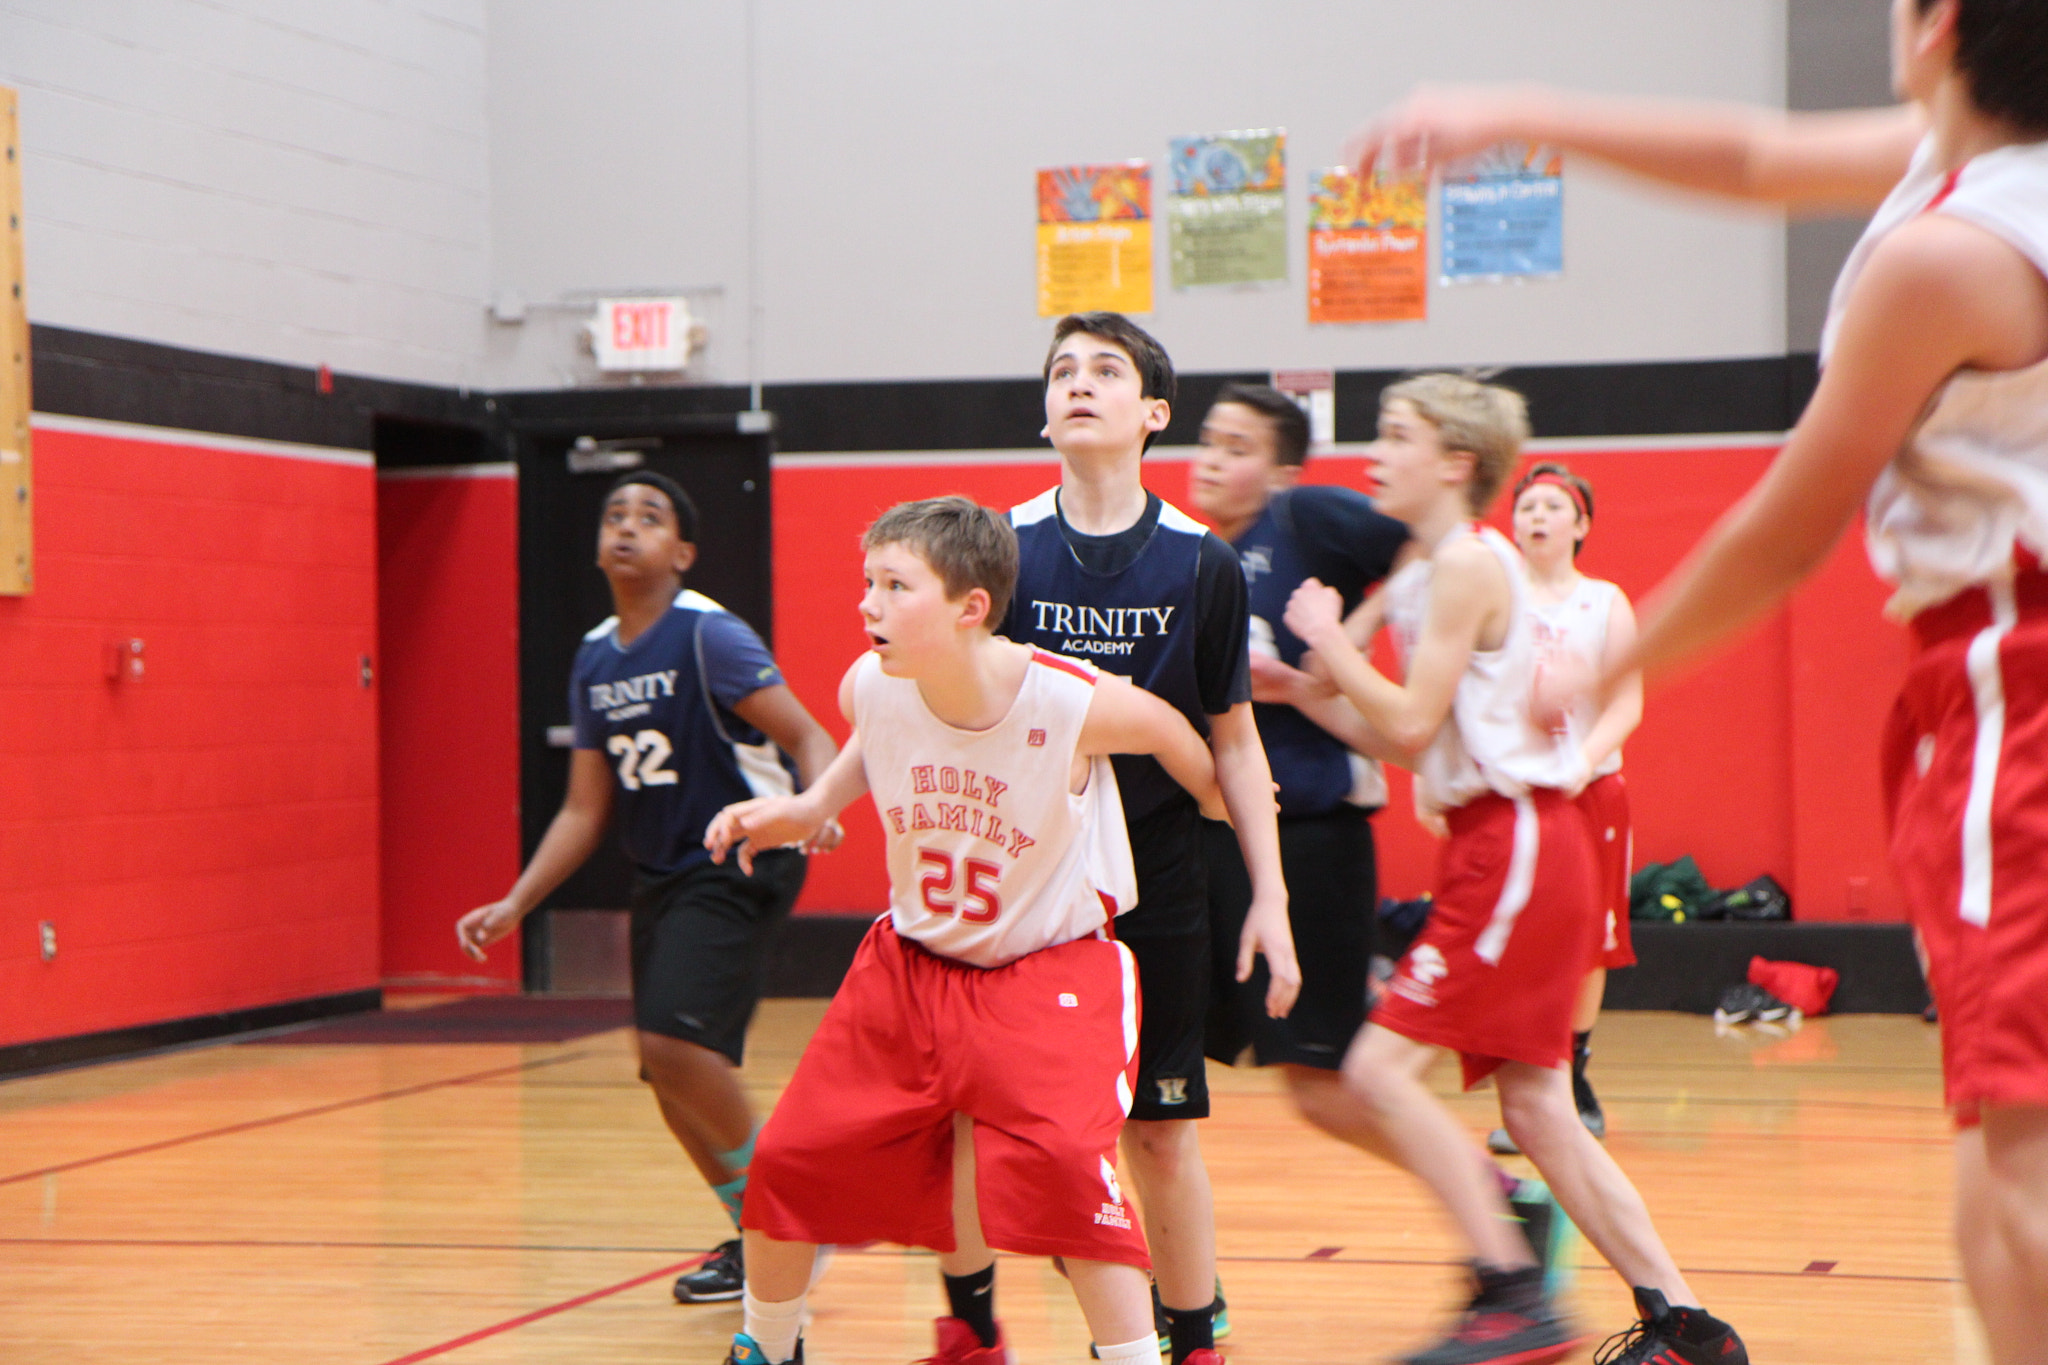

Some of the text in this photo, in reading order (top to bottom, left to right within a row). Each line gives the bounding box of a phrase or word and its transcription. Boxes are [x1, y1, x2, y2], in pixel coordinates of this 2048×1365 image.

[612, 303, 674, 350] EXIT
[1031, 600, 1175, 637] TRINITY
[1061, 638, 1135, 655] ACADEMY
[606, 729, 679, 791] 22
[911, 765, 1008, 808] HOLY
[887, 802, 1036, 859] FAMILY
[918, 846, 1003, 925] 25
